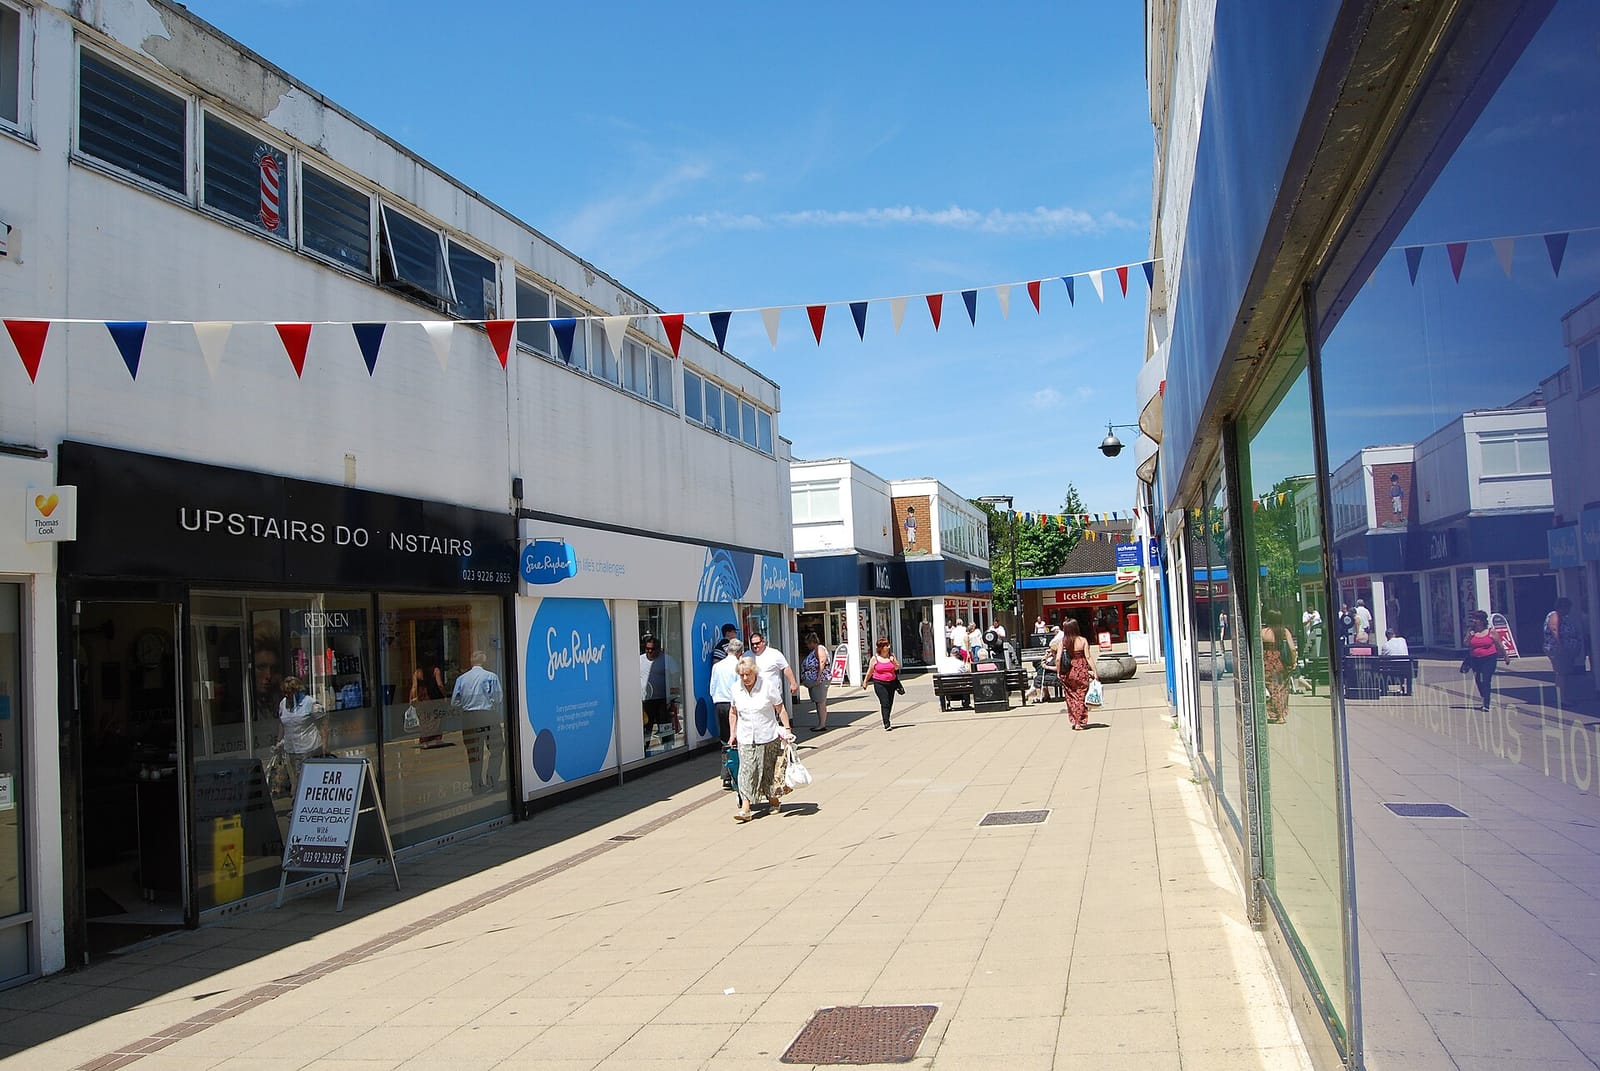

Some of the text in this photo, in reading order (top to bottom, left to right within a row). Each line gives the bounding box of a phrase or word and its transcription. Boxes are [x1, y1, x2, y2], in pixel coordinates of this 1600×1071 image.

[181, 507, 473, 557] UPSTAIRS DONSTAIRS
[526, 555, 543, 574] Sue
[544, 556, 571, 574] Ryder
[462, 569, 475, 580] 023
[477, 570, 494, 582] 9226
[304, 612, 349, 627] REDKEN
[547, 627, 605, 680] Sue Ryder
[1413, 662, 1451, 737] Men
[1463, 672, 1522, 764] Kids
[323, 771, 341, 784] EAR
[305, 787, 353, 801] PIERCING
[301, 807, 351, 815] AVAILABLE
